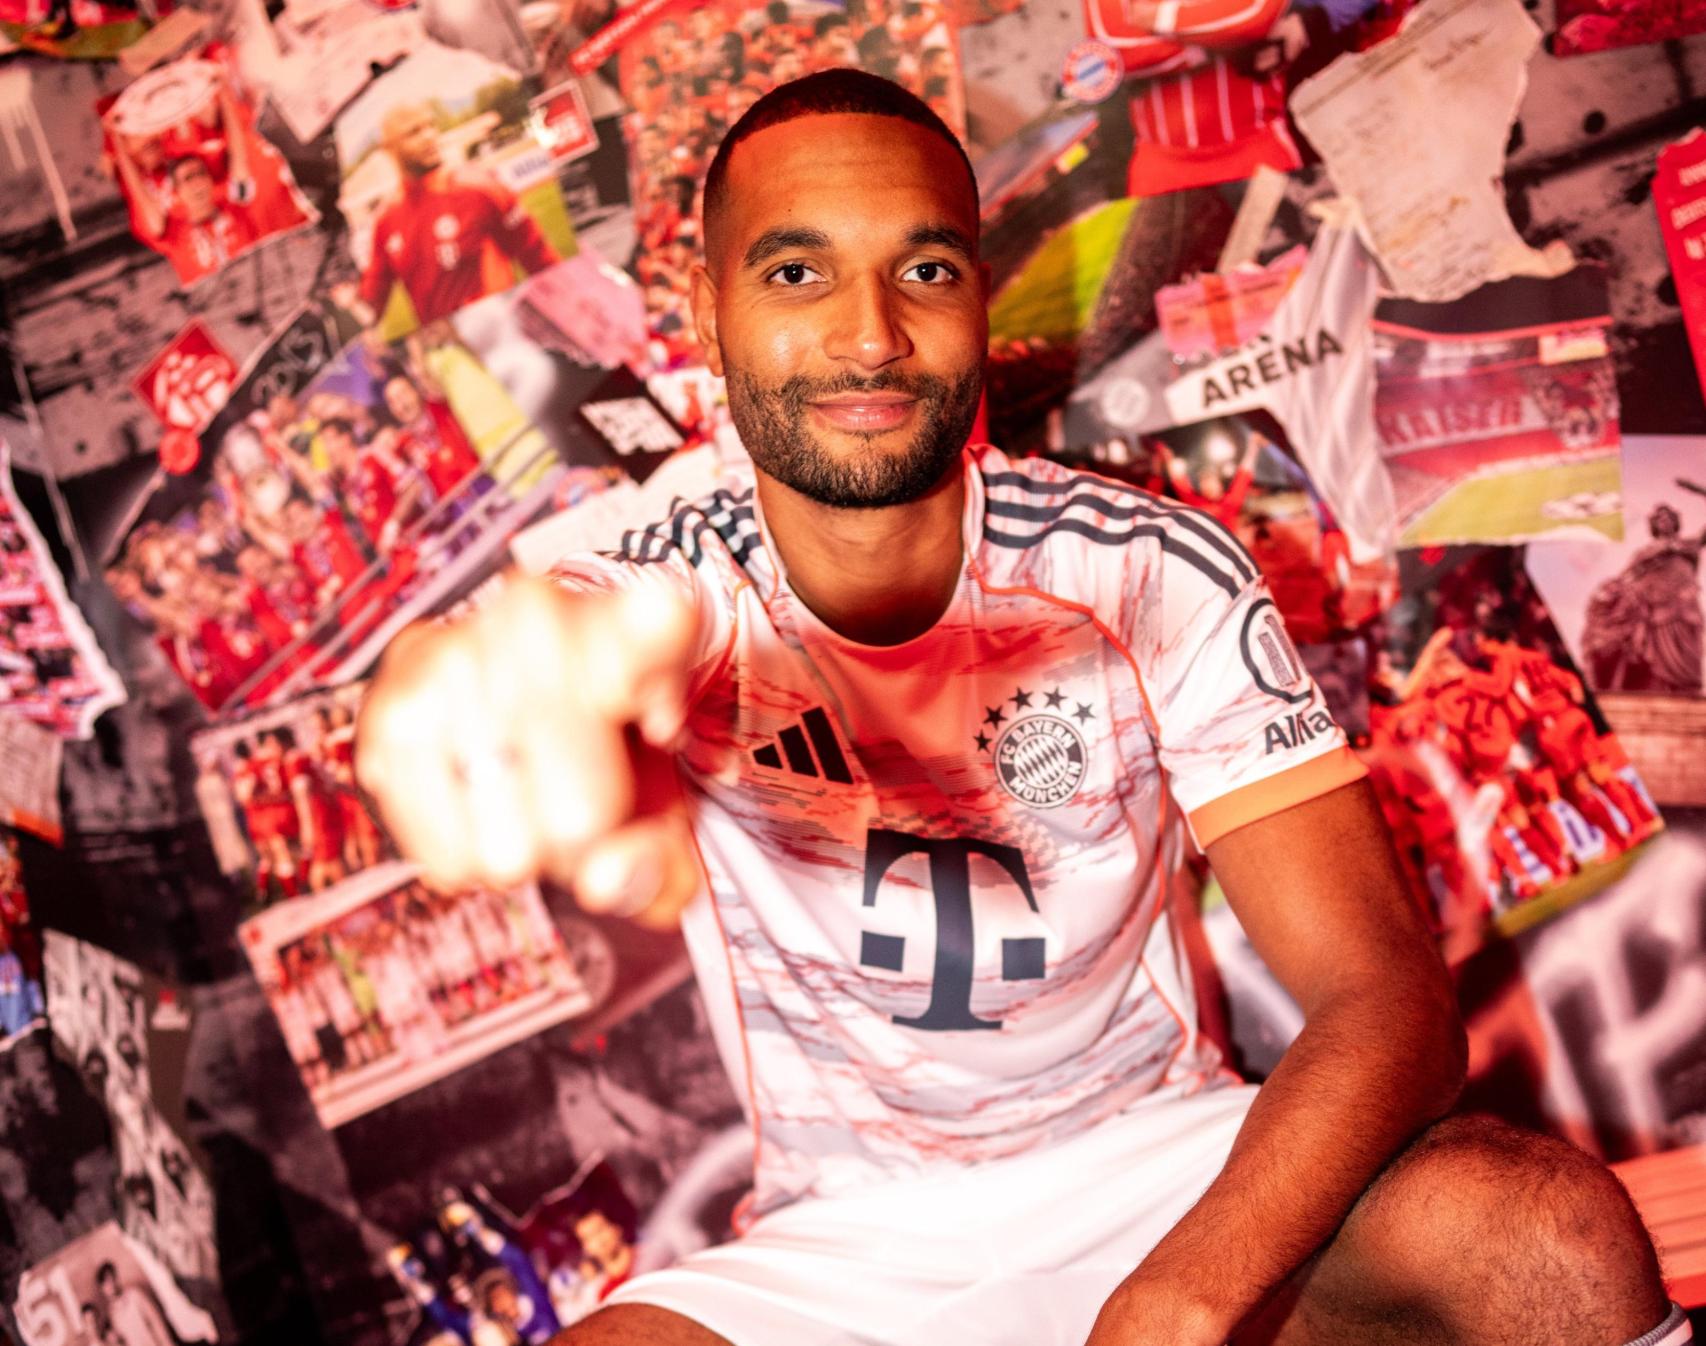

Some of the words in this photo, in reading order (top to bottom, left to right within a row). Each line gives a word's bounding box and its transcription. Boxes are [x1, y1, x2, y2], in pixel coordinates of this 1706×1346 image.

[1202, 328, 1343, 407] ARENA
[1001, 743, 1015, 764] FC
[1011, 720, 1076, 748] BAYERN
[861, 827, 1041, 1031] T
